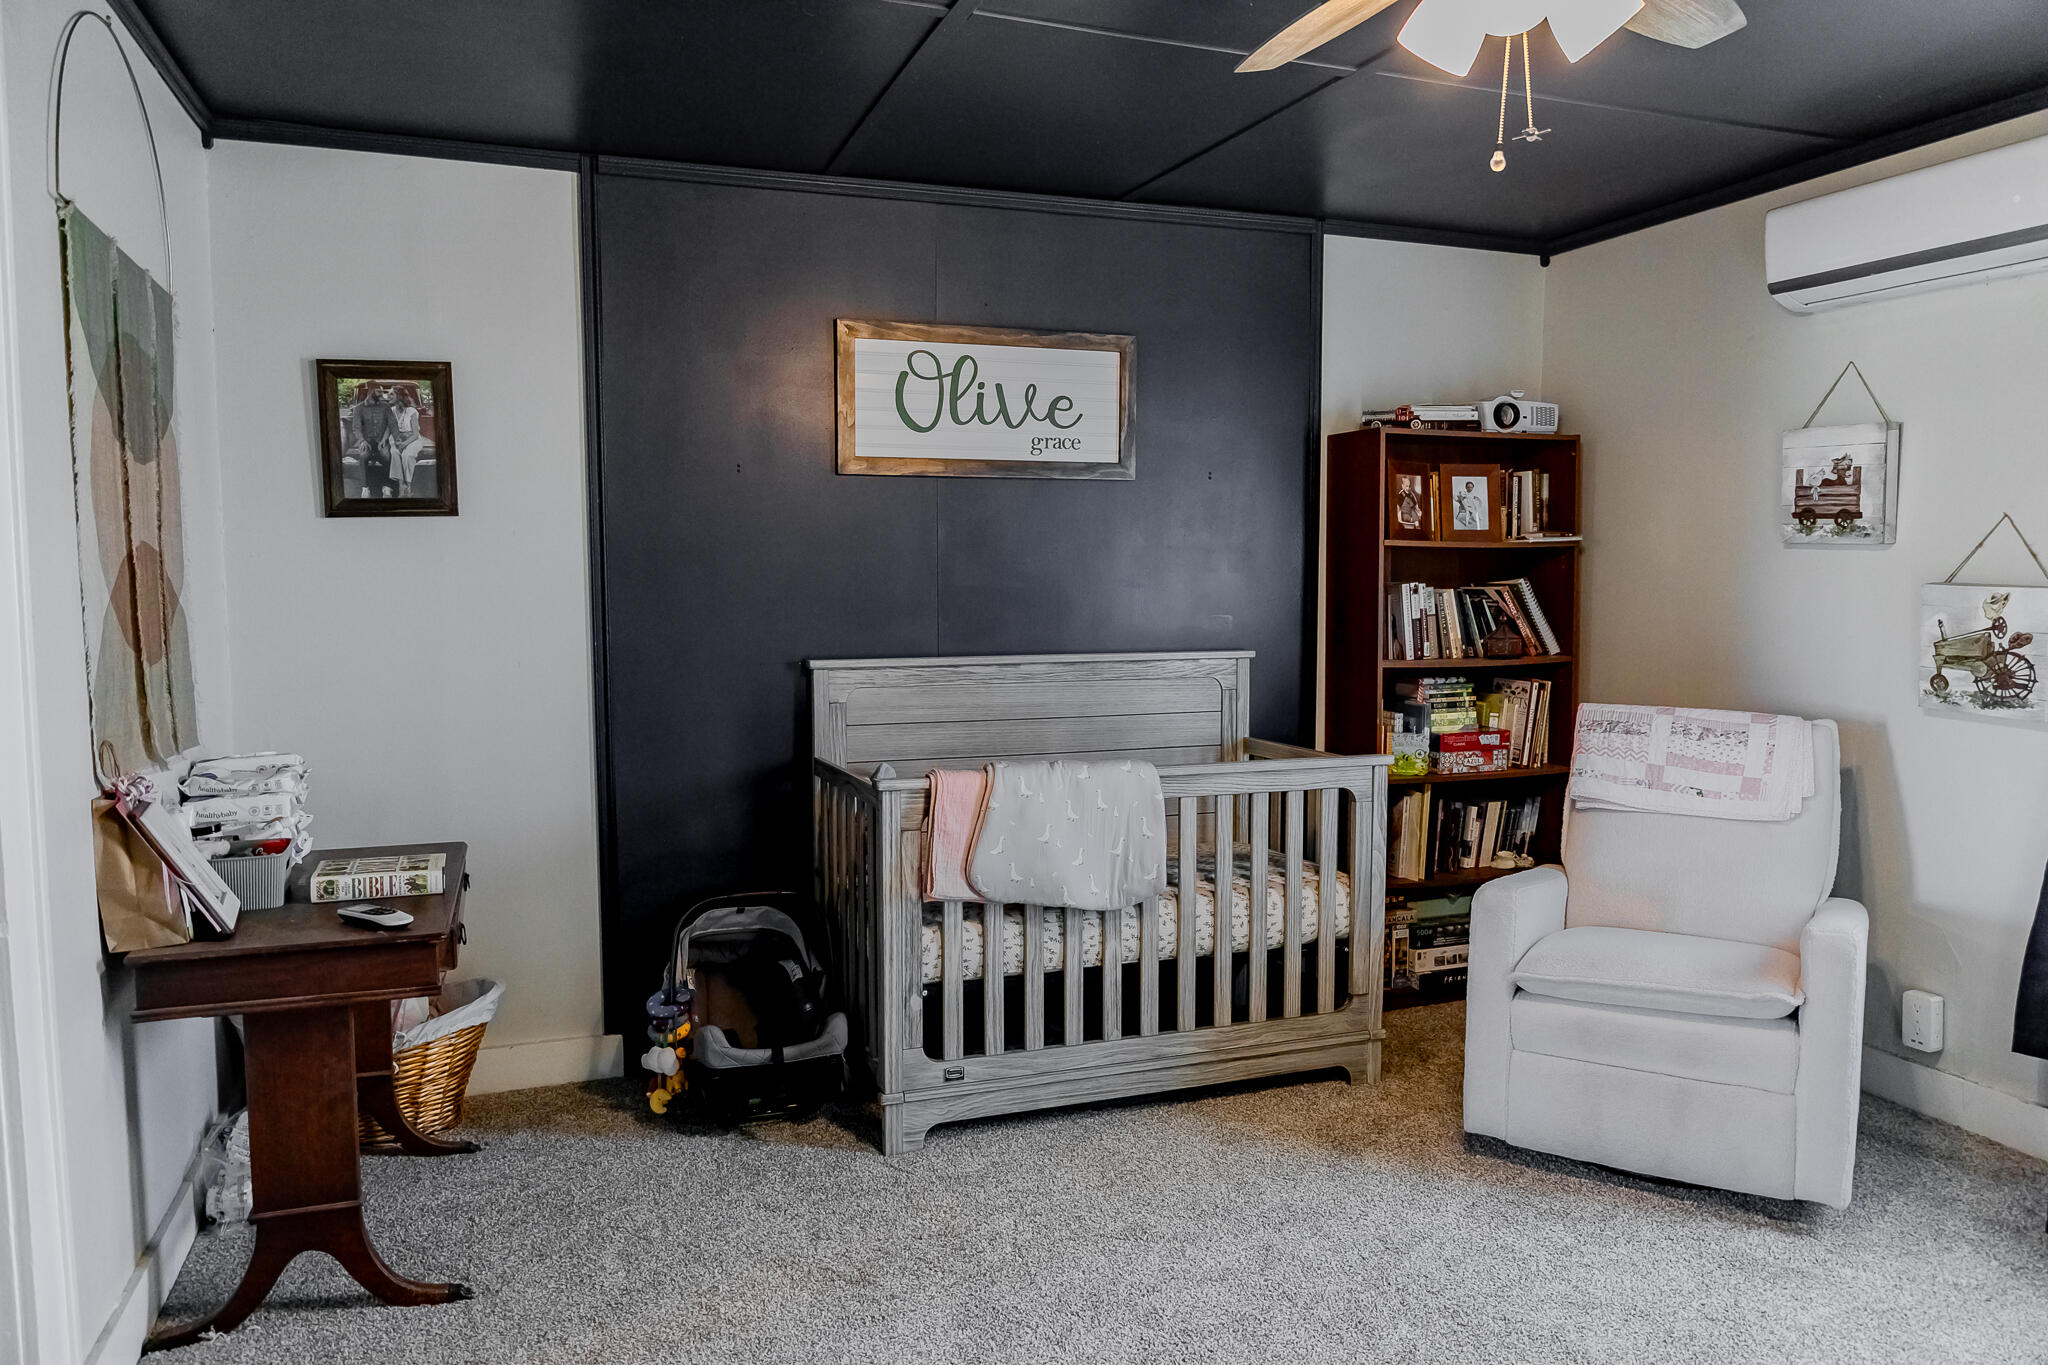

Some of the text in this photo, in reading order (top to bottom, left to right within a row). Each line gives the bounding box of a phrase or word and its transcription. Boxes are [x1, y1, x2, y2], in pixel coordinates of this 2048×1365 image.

[895, 349, 1084, 433] Olive
[1030, 434, 1082, 457] grace
[195, 810, 238, 820] healthybaby
[351, 875, 398, 899] BIBLE
[1385, 914, 1414, 923] ANCALA
